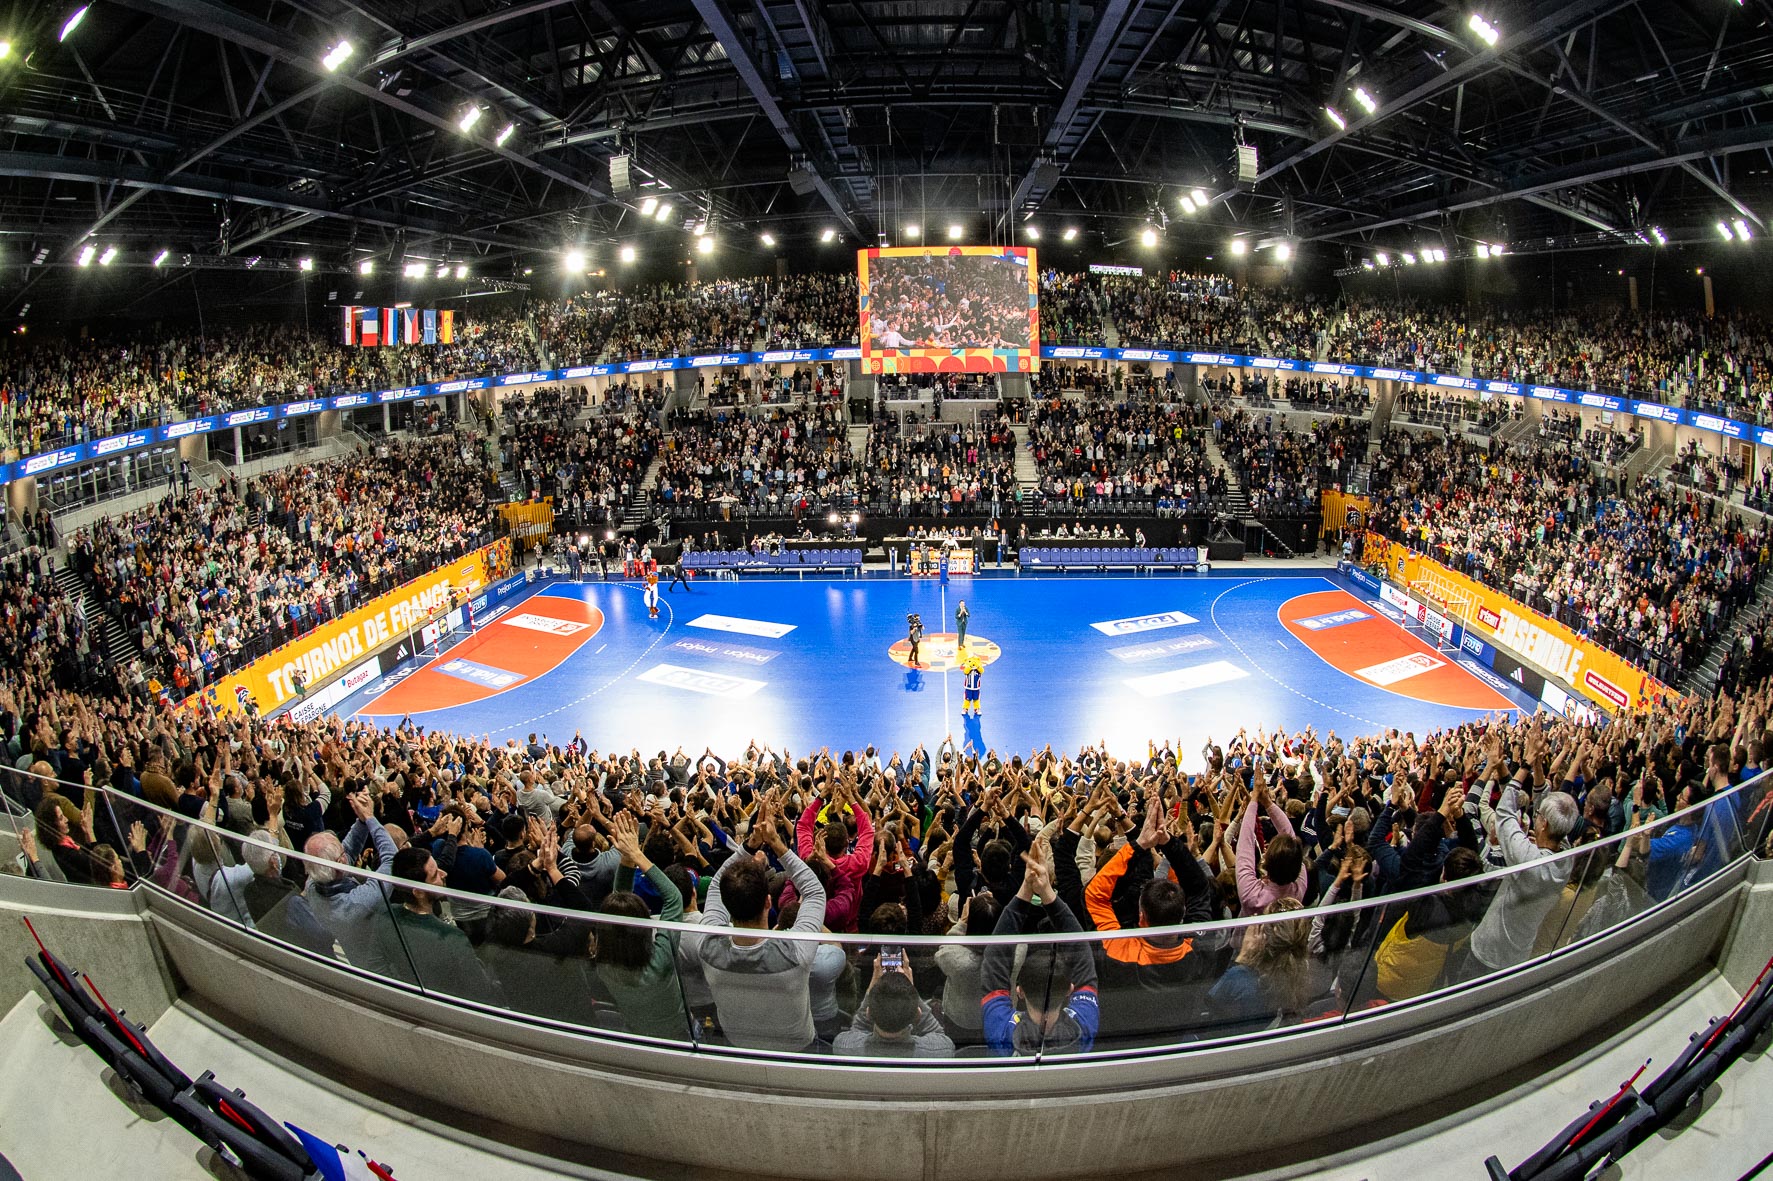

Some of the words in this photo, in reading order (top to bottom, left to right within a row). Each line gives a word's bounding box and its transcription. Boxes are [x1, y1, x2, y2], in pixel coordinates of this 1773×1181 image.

[267, 625, 364, 701] TOURNOI
[363, 611, 390, 649] DE
[390, 578, 450, 634] FRANCE
[1493, 607, 1585, 687] ENSEMBLE
[347, 670, 369, 688] Butagaz
[294, 702, 315, 720] CAISSE
